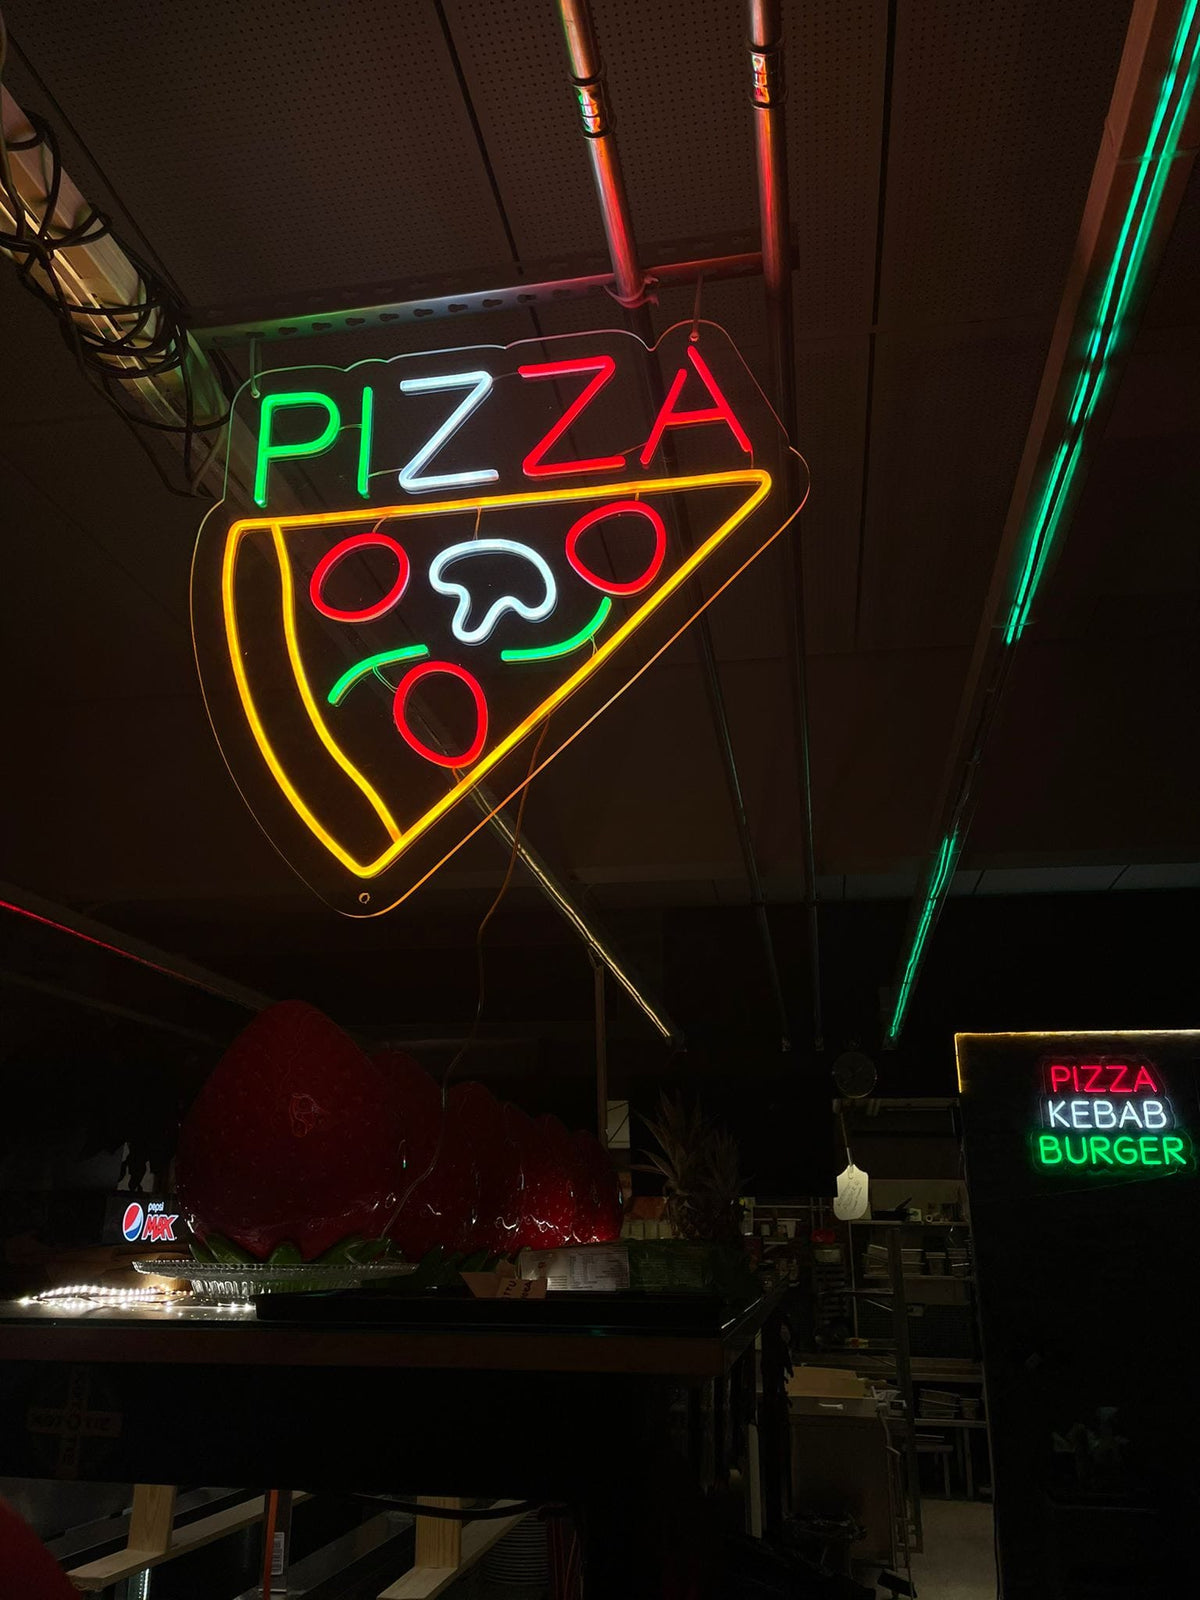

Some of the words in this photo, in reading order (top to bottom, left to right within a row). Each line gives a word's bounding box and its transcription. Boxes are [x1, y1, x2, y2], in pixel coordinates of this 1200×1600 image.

[254, 345, 752, 507] PIZZA
[1050, 1065, 1157, 1093] PIZZA
[1048, 1100, 1167, 1129] KEBAB
[1039, 1135, 1187, 1165] BURGER
[141, 1214, 179, 1242] MAX
